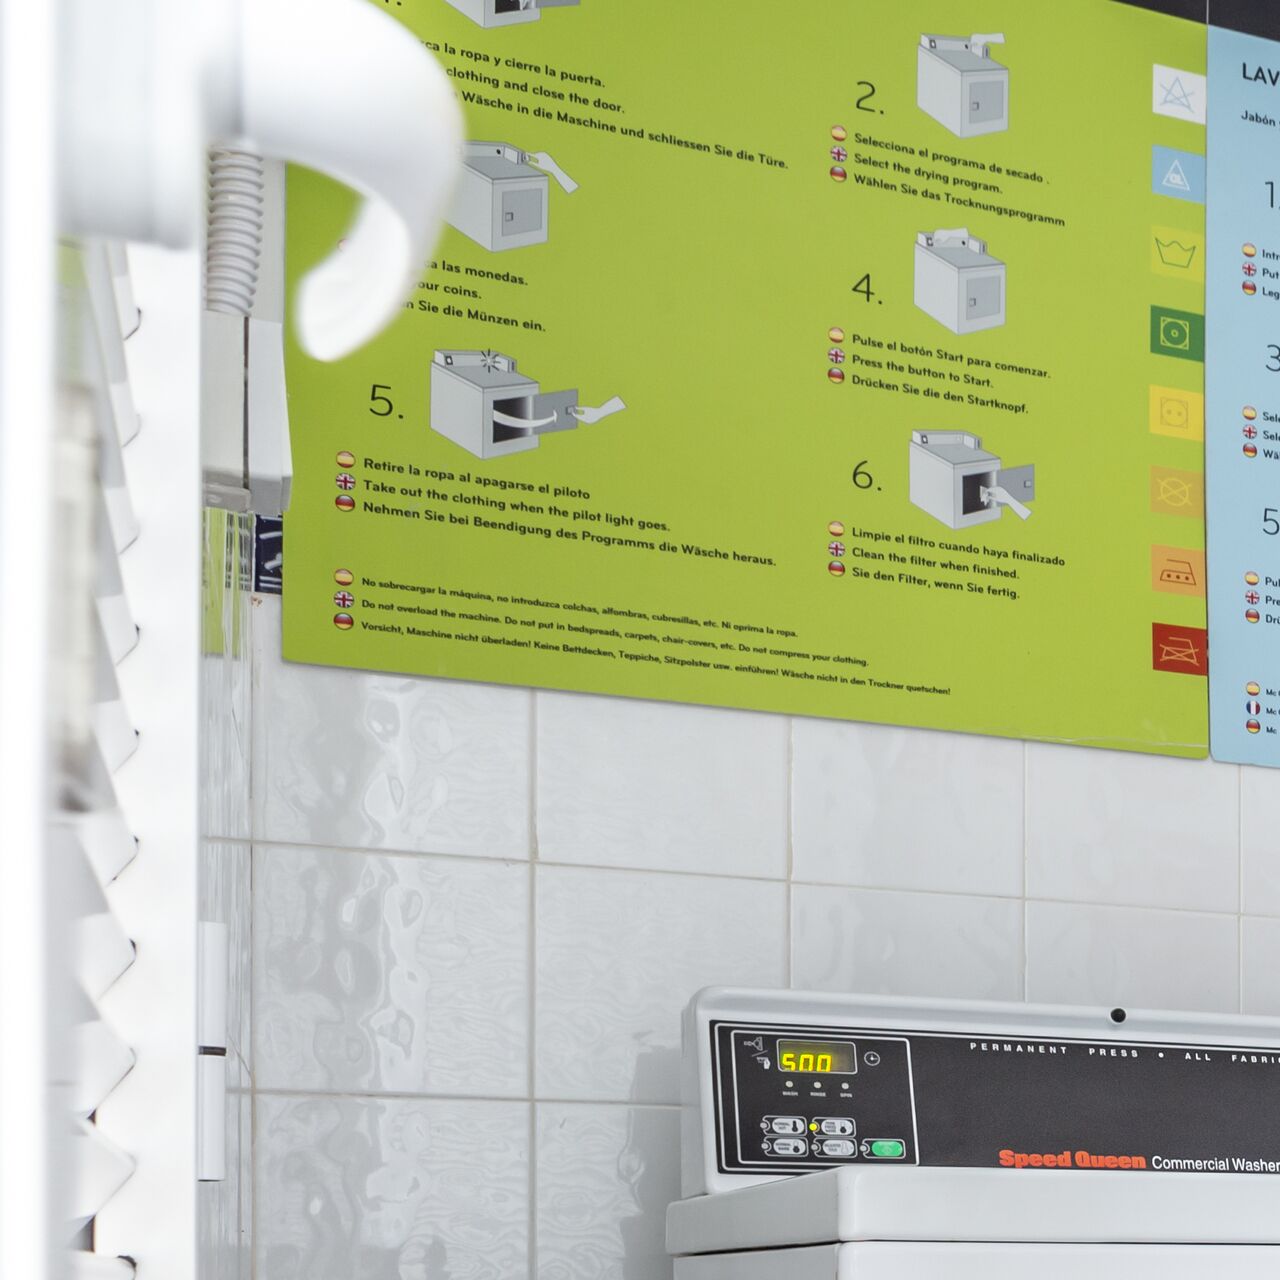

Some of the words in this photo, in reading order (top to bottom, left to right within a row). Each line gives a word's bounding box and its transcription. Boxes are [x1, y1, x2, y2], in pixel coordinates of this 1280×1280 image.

[444, 42, 456, 55] la
[460, 49, 490, 62] ropa
[493, 56, 501, 66] y
[504, 58, 541, 73] cierre
[545, 64, 556, 77] la
[560, 71, 605, 87] puerta.
[503, 80, 528, 92] and
[532, 85, 565, 100] close
[569, 92, 589, 105] the
[593, 98, 624, 113] door.
[855, 81, 884, 115] 2.
[854, 153, 889, 169] Select
[892, 162, 911, 174] the
[914, 167, 949, 184] drying
[952, 177, 1002, 193] program.
[853, 173, 897, 191] Wählen
[900, 183, 918, 196] Sie
[921, 188, 941, 200] das
[944, 192, 1065, 226] Trocknungsprogramm
[442, 260, 460, 273] las
[465, 267, 528, 285] monedas.
[851, 273, 882, 305] 4.
[418, 300, 439, 313] Sie
[442, 305, 463, 317] die
[467, 308, 518, 327] Münzen
[522, 319, 545, 332] ein.
[852, 354, 882, 369] Press
[886, 361, 904, 372] the
[908, 364, 945, 379] button
[949, 372, 960, 382] to
[963, 373, 993, 387] Start.
[369, 384, 403, 419] 5.
[363, 457, 404, 473] Retire
[408, 464, 420, 476] la
[425, 469, 454, 481] ropa
[459, 472, 470, 483] al
[475, 476, 534, 491] apagarse
[538, 483, 549, 494] el
[553, 486, 590, 499] piloto
[852, 460, 882, 491] 6.
[852, 547, 884, 560] Clean
[888, 552, 906, 563] the
[910, 555, 936, 567] filter
[939, 560, 969, 572] when
[972, 564, 1019, 579] finished.
[970, 1042, 1067, 1054] PERMANENT
[1089, 1048, 1138, 1058] PRESS
[1185, 1052, 1211, 1061] ALL
[999, 1149, 1071, 1169] Speed
[1074, 1151, 1147, 1169] Queen
[1151, 1155, 1230, 1171] Commercial
[1231, 1158, 1280, 1172] Washer
